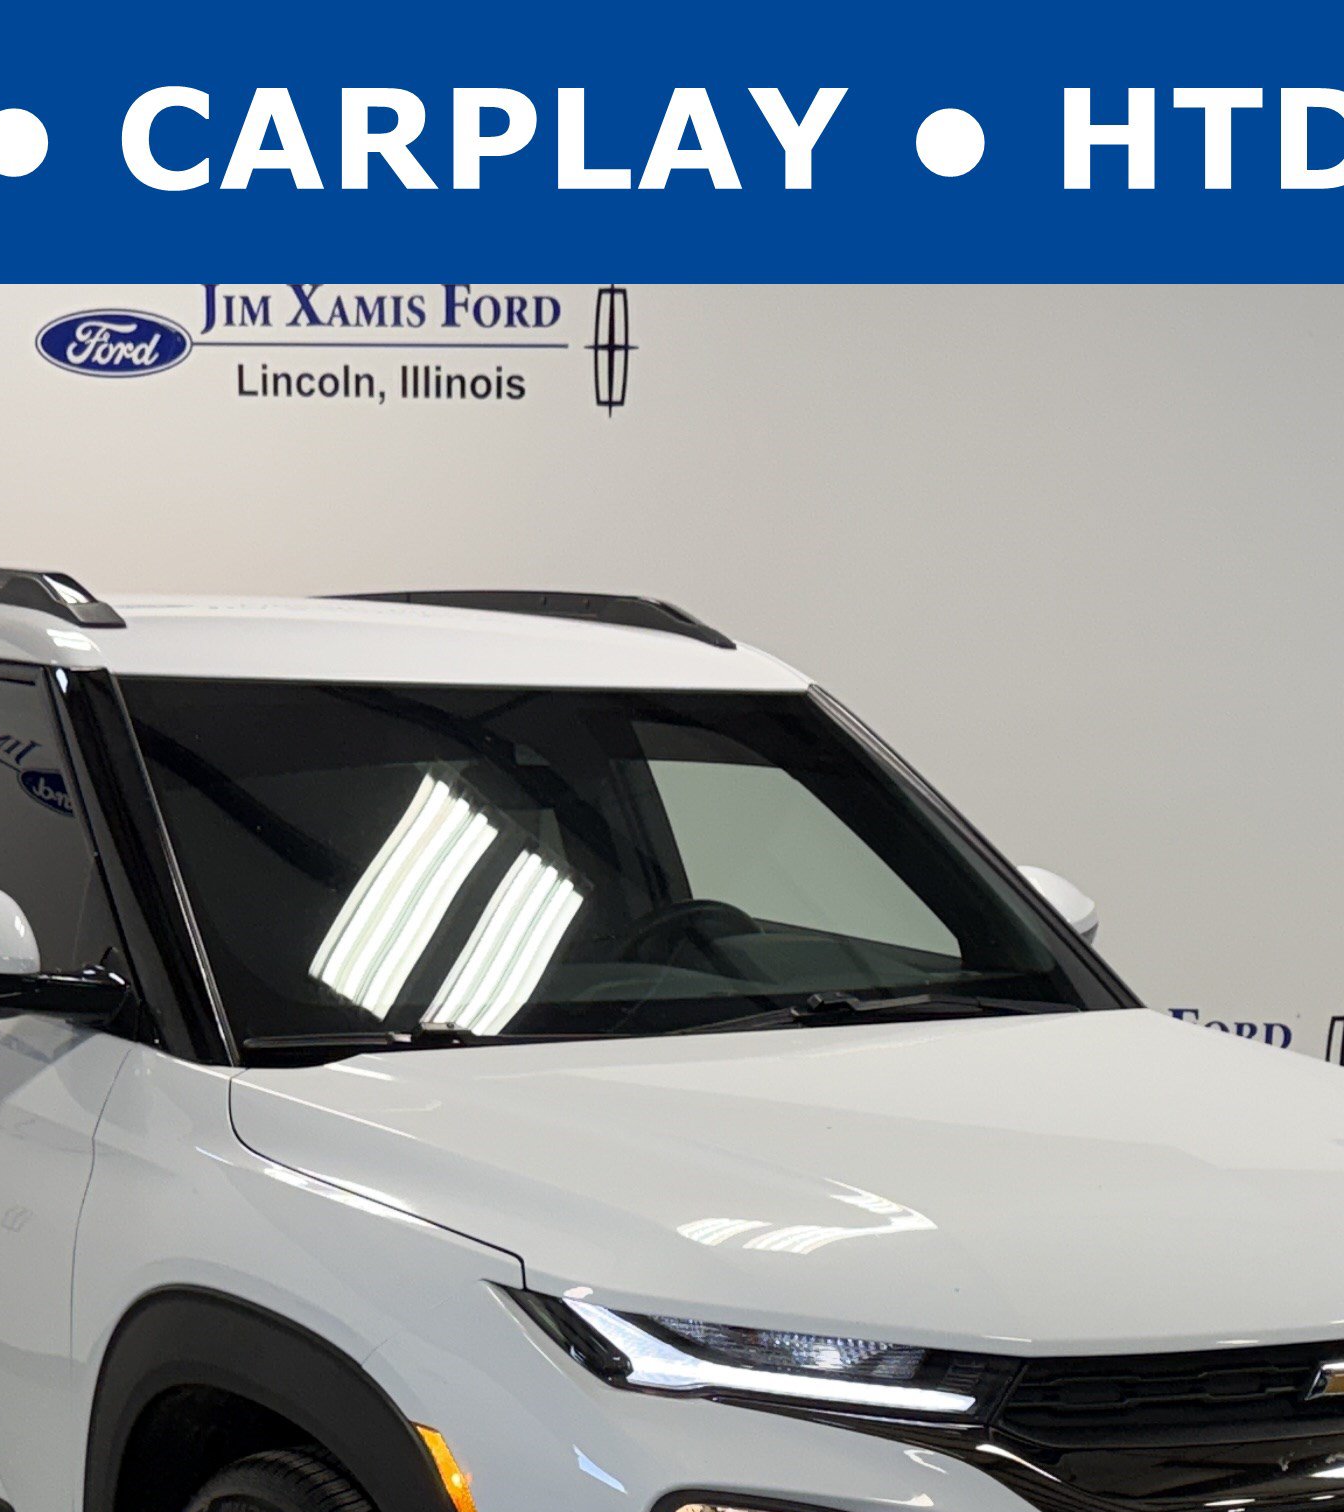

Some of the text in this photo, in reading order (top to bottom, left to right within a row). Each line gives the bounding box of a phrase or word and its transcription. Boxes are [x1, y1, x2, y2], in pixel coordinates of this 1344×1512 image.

[201, 284, 562, 335] JIM XAMIS FORD
[65, 320, 159, 366] Ford
[237, 364, 527, 404] Lincoln, Illinois
